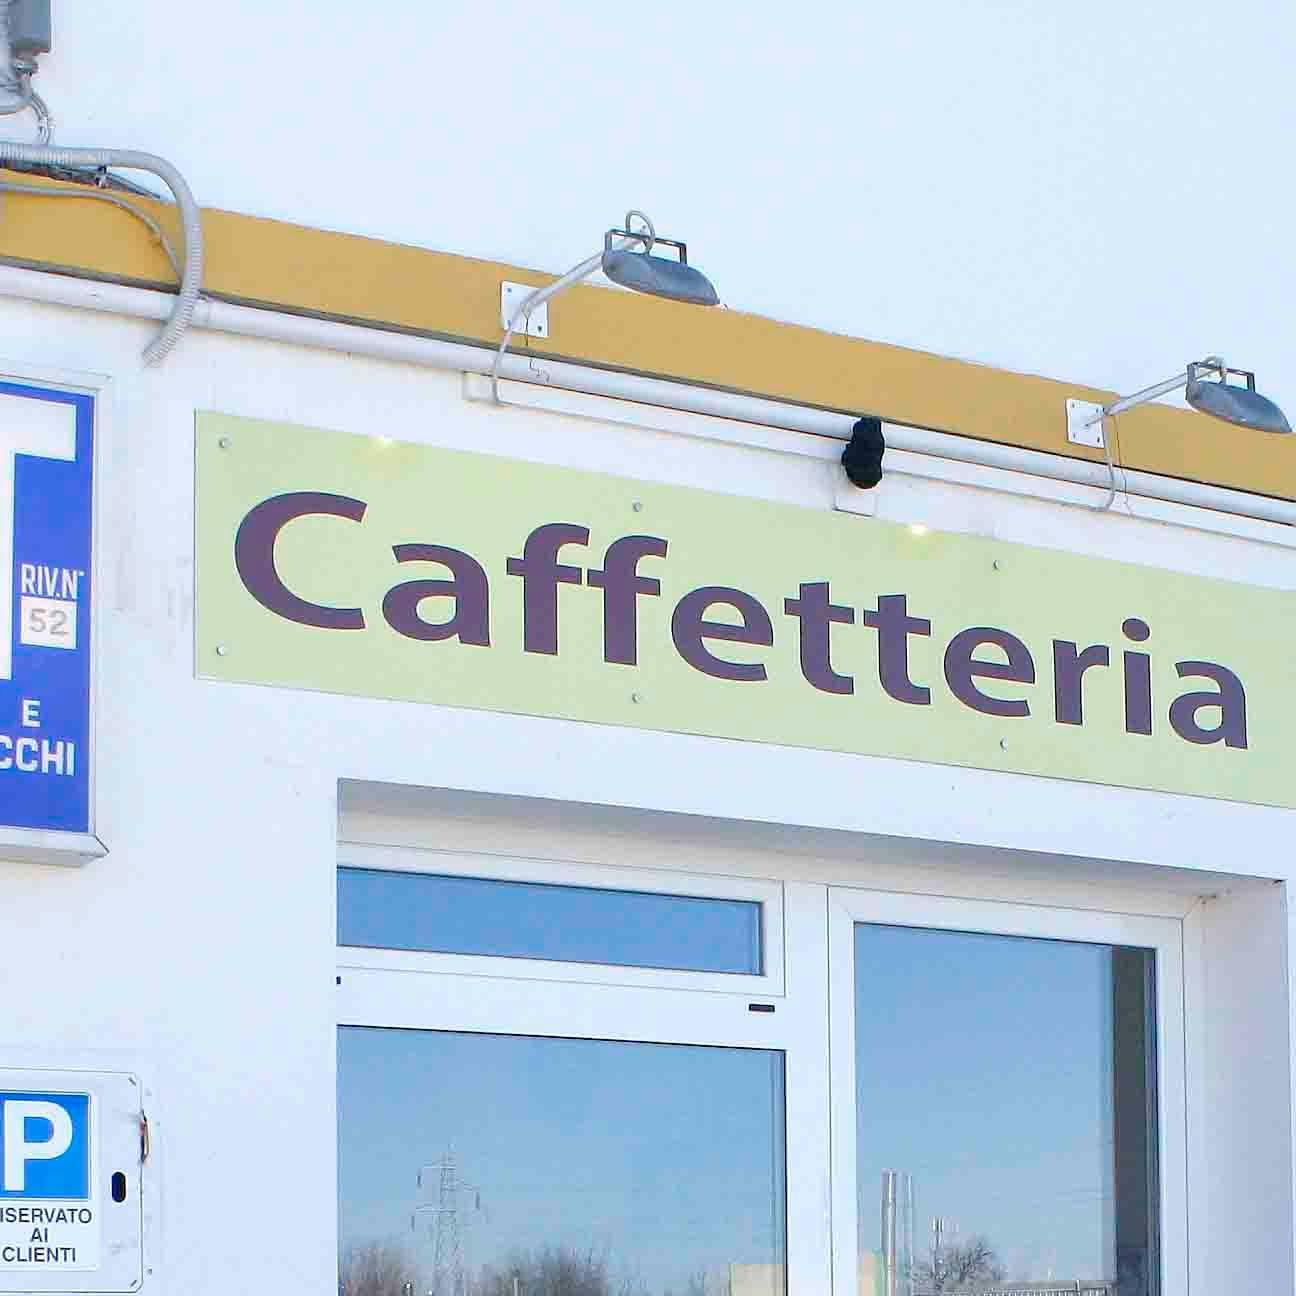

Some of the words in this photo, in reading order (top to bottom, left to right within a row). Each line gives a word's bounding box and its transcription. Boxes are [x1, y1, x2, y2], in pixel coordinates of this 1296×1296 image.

[29, 608, 70, 637] 52
[234, 490, 1249, 750] Caffetteria
[22, 698, 41, 728] E
[4, 1099, 73, 1191] P
[30, 1227, 48, 1243] AI
[2, 1246, 76, 1263] CLIENTI
